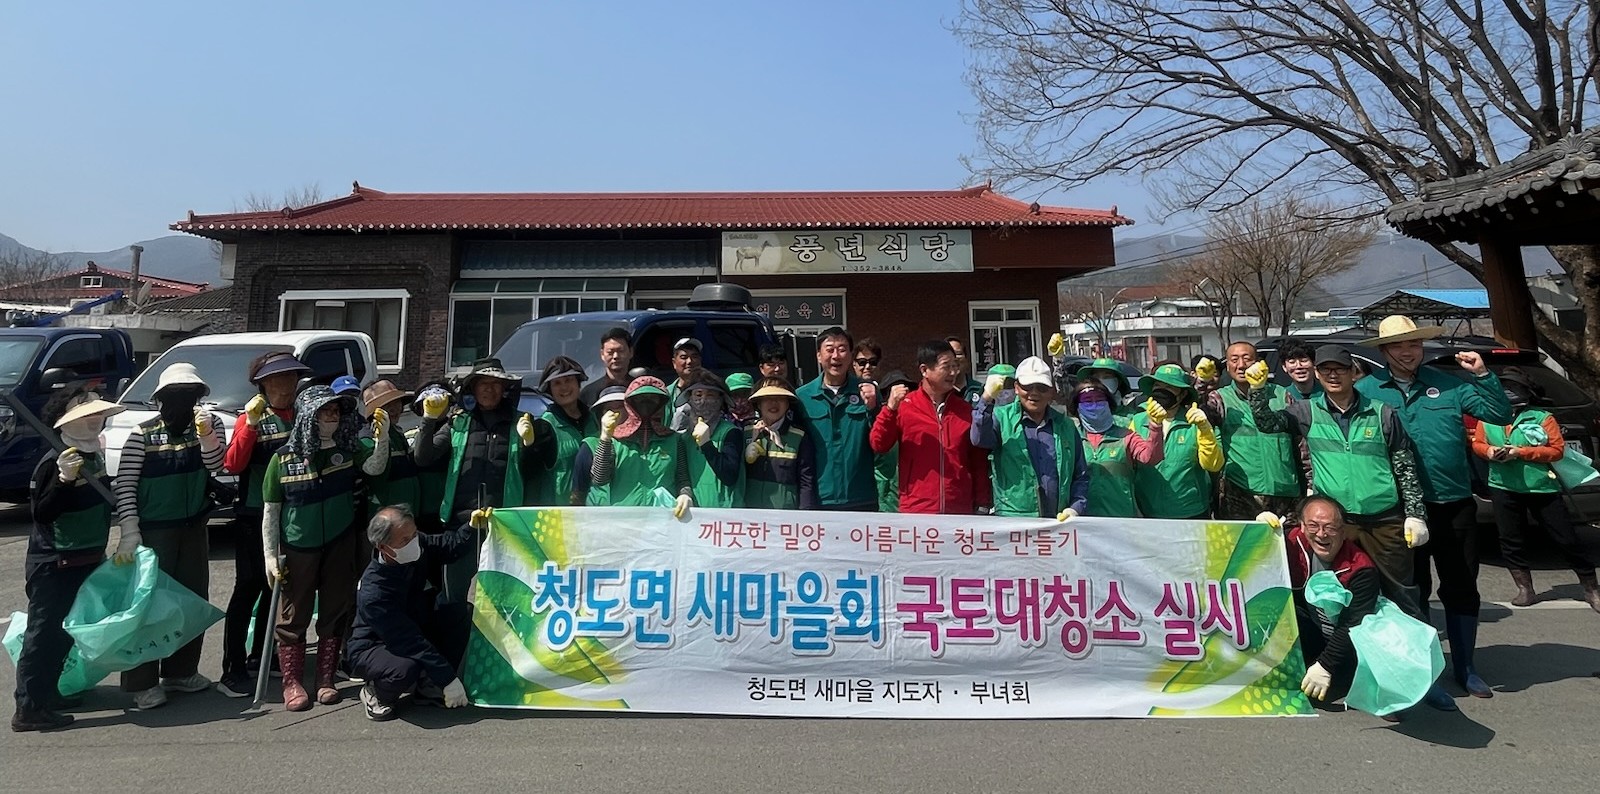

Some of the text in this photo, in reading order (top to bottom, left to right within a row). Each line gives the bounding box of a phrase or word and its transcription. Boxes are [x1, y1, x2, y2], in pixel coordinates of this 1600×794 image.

[790, 233, 954, 262] 풍년식당
[698, 521, 1079, 557] 깨끗한 밀양 아름다운 청도 만들기
[535, 565, 1245, 656] 청도면 새마을회 국토대청소 실시
[747, 678, 1031, 704] 청도면 새마을 지도자 부녀회
